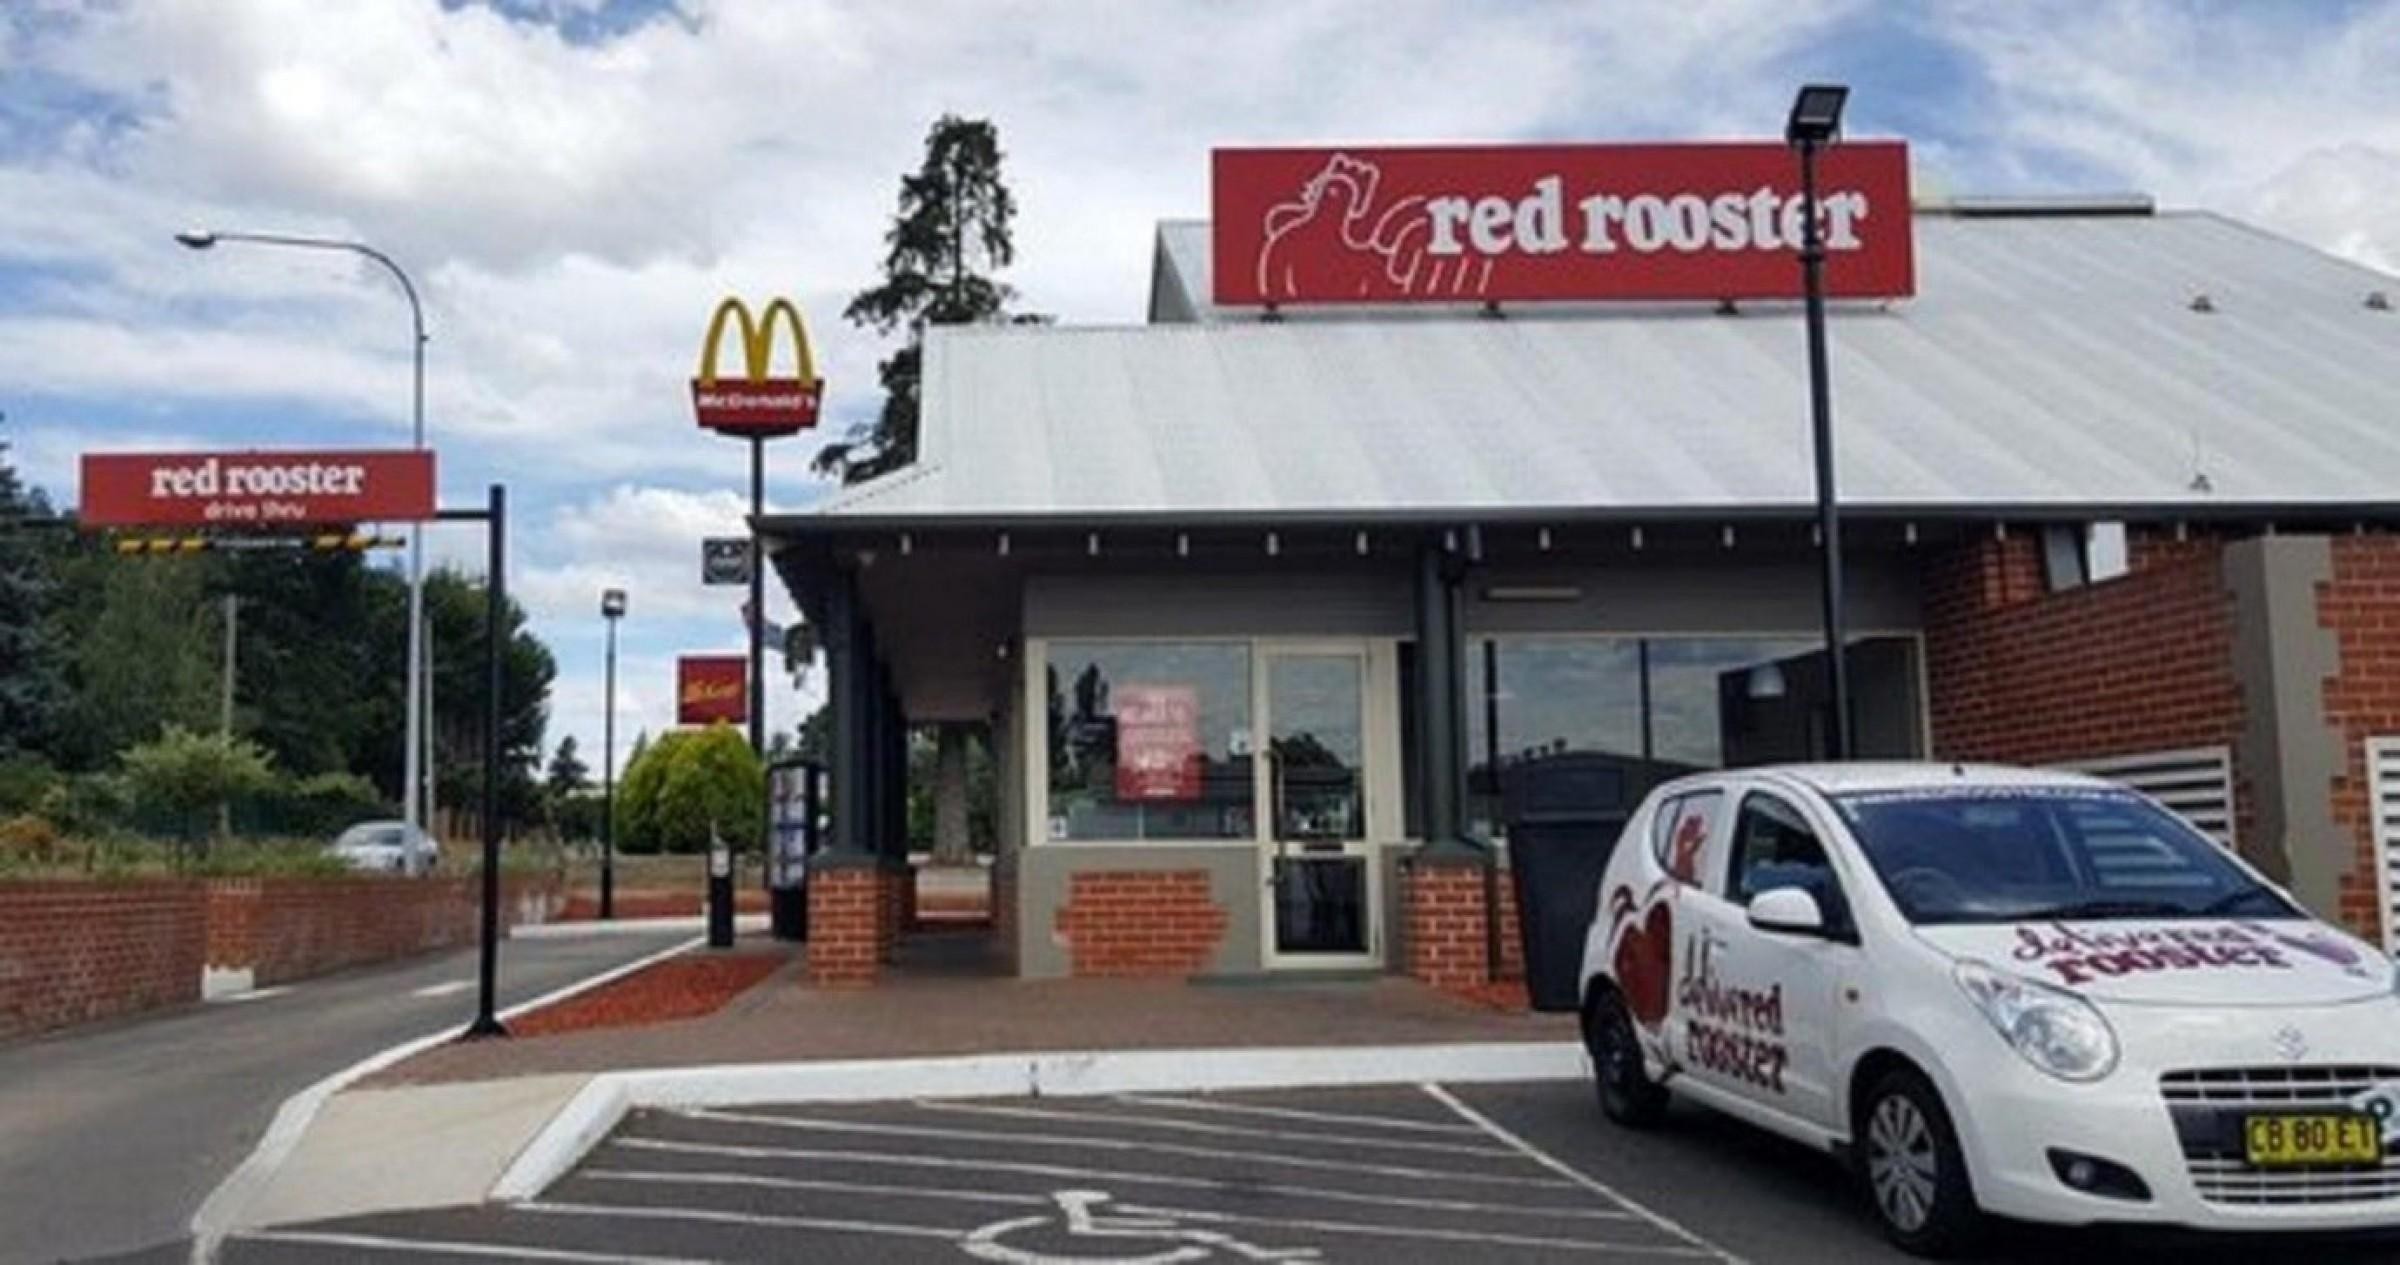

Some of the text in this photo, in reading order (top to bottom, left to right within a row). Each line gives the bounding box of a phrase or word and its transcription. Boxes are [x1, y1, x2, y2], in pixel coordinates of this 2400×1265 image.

[1427, 176, 1868, 254] red rooster
[152, 457, 364, 496] red rooster
[204, 501, 306, 519] drive thru
[2046, 942, 2293, 983] rooster
[1688, 1020, 1787, 1094] rooster
[2294, 1119, 2328, 1152] 80
[2338, 1116, 2372, 1149] ET
